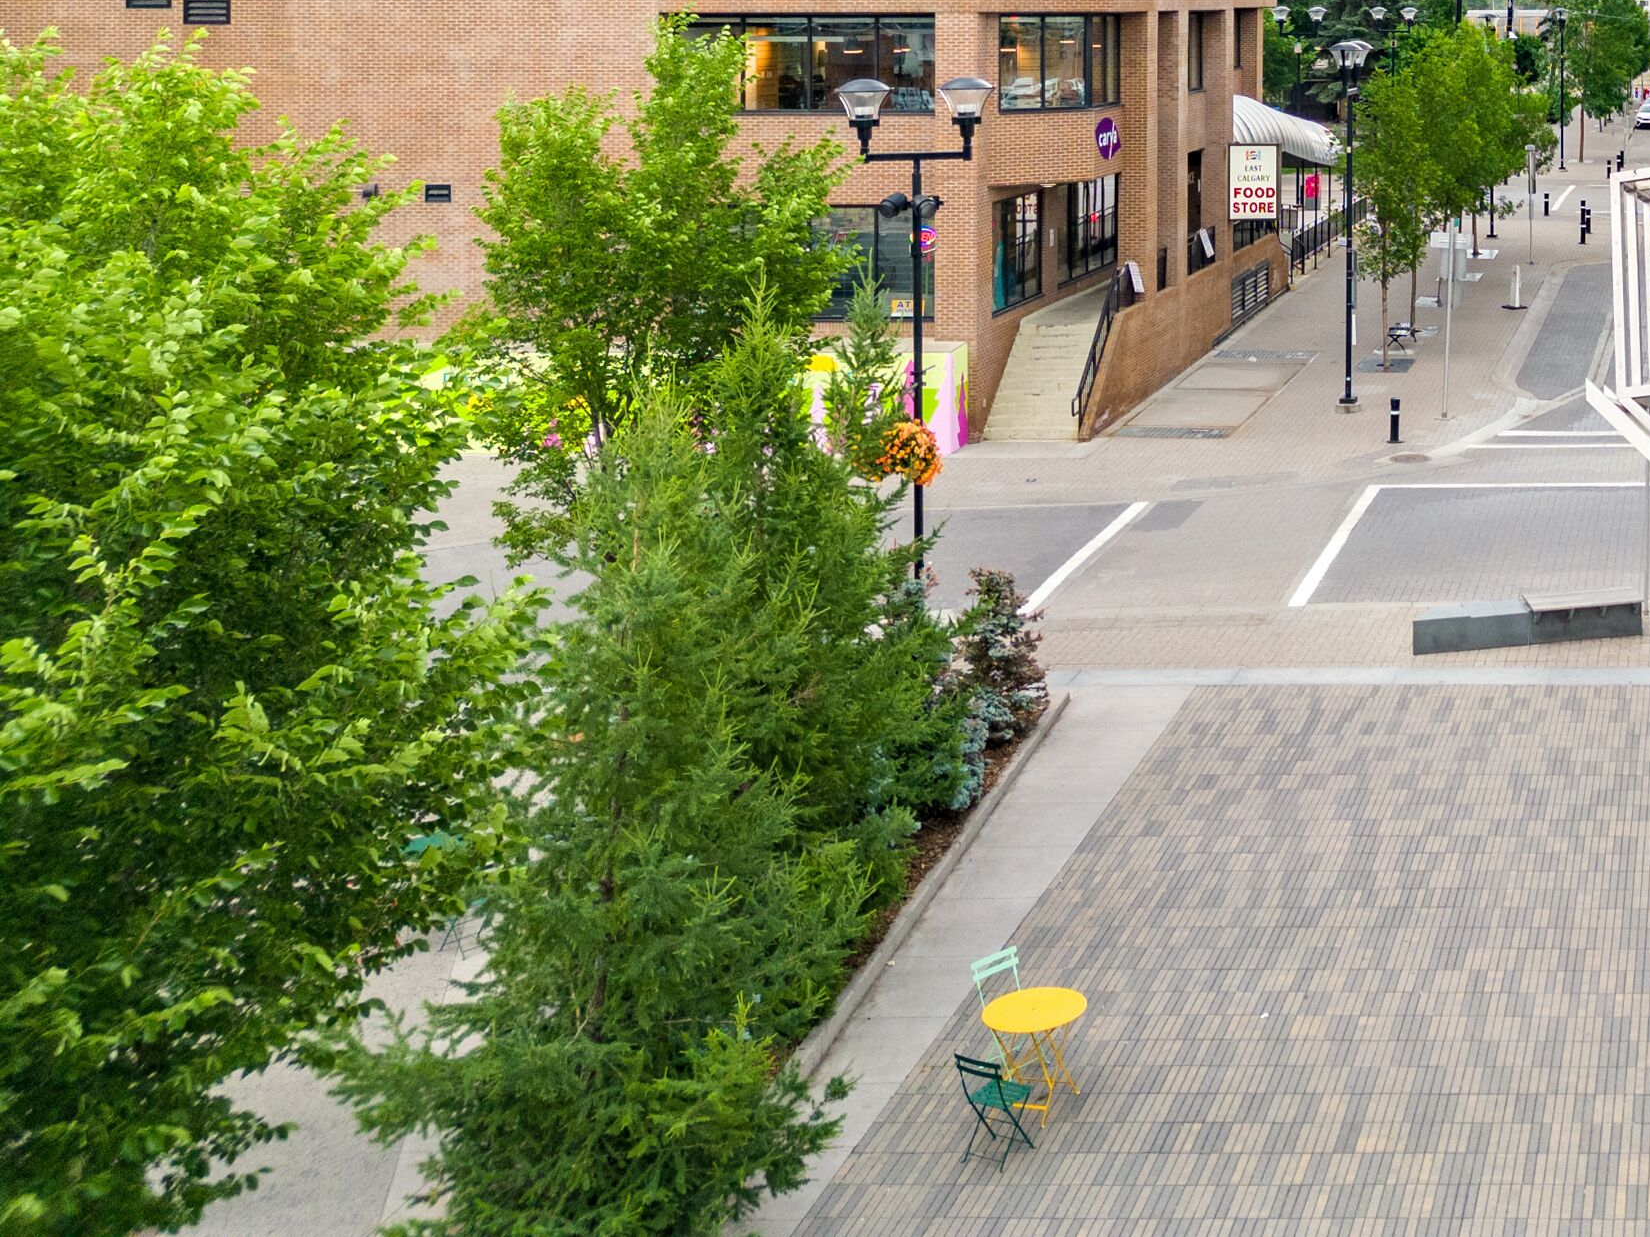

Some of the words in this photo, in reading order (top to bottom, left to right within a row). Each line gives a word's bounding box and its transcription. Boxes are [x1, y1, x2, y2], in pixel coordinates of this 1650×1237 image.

[1237, 174, 1271, 182] CALGARY
[1233, 187, 1276, 198] FOOD
[1233, 201, 1275, 214] STORE
